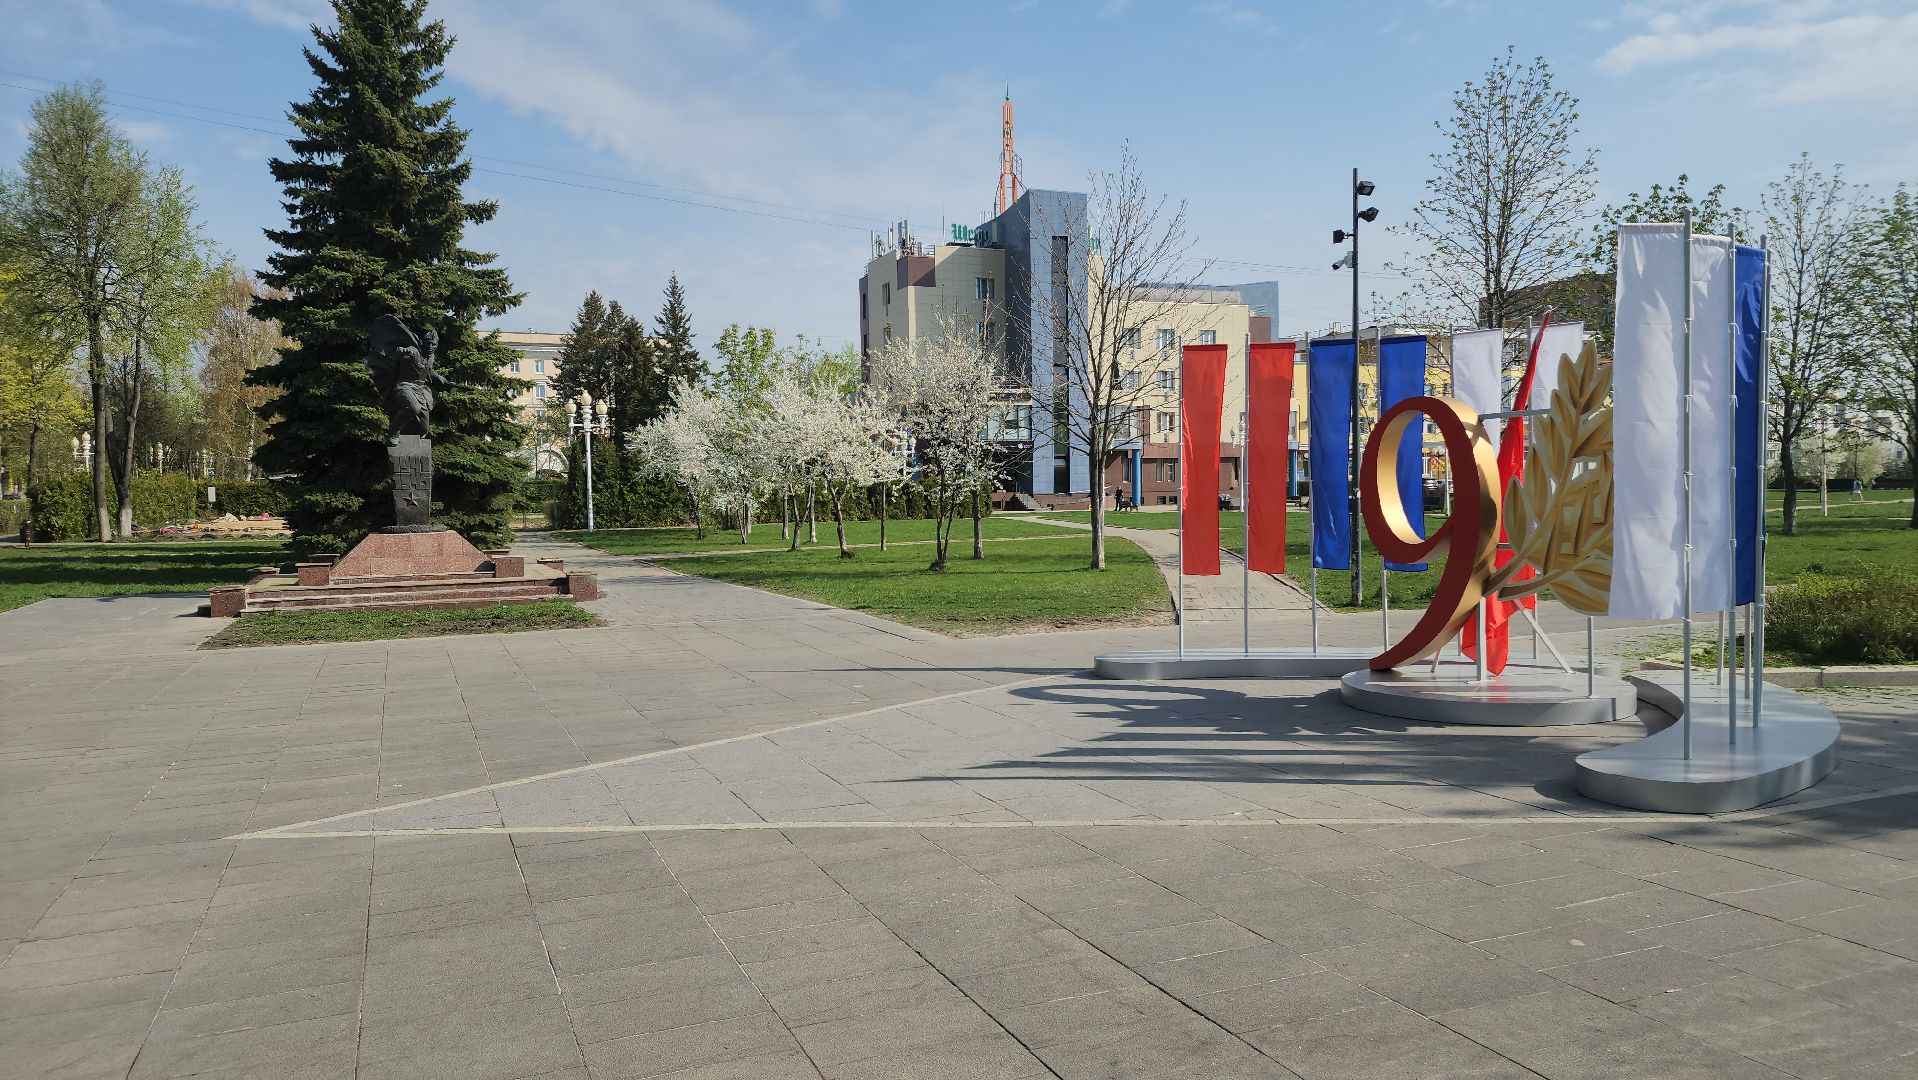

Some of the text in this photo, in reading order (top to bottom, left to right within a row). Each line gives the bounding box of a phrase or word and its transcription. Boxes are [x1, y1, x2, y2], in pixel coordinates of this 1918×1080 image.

[390, 456, 430, 472] 1941
[391, 473, 430, 489] 1945
[1360, 396, 1500, 671] 9
